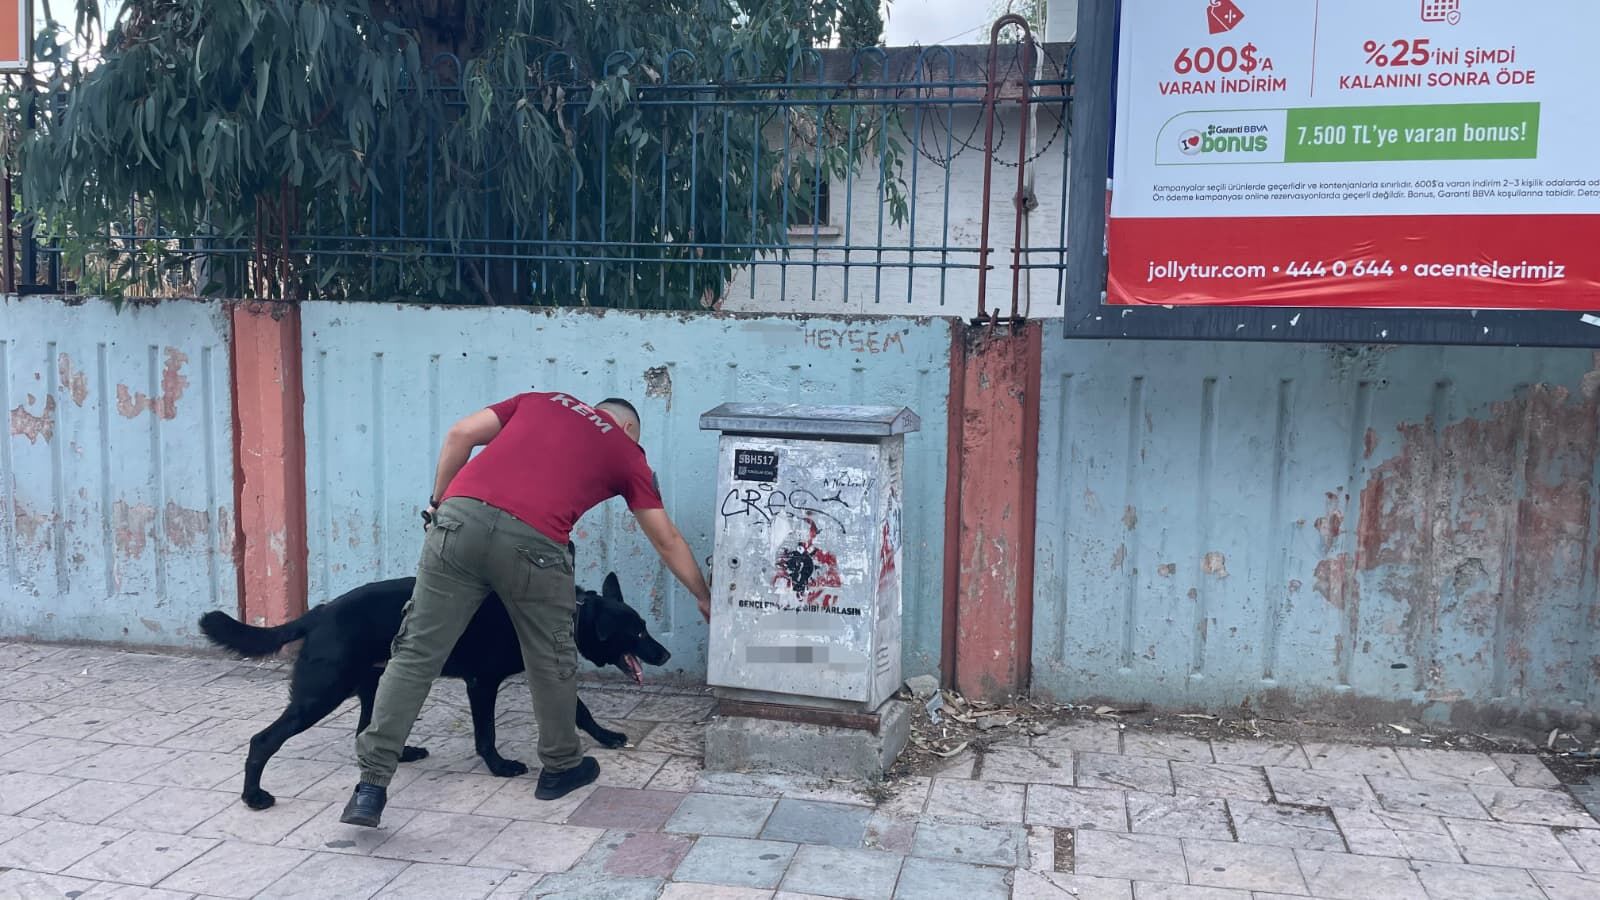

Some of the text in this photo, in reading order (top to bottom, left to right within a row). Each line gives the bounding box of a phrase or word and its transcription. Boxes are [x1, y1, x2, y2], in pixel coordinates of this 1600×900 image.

[1174, 42, 1273, 75] 600$'A
[1363, 38, 1516, 68] %25'İNİ ŞİMDİ
[1159, 74, 1287, 95] VARAN İNDİRİM
[1339, 67, 1536, 89] KALANINI SONRA ÖDE
[1216, 125, 1268, 134] Garanti BBVA
[1297, 121, 1527, 148] 7.500 TL'ye varan bonus!
[1201, 132, 1268, 152] bonus
[1153, 184, 1205, 192] Kampanyalar
[1228, 183, 1265, 191] ürünlerde
[1545, 178, 1586, 186] odalarda
[1195, 193, 1243, 201] kampanyası
[1271, 191, 1341, 200] rezervasyonlarda
[1437, 190, 1471, 198] Garanti
[1472, 189, 1496, 197] BBVA
[1147, 260, 1566, 282] jollytur.com 444 0 644 acentelerimiz
[804, 328, 905, 354] HEYSEM
[549, 394, 614, 434] KEM
